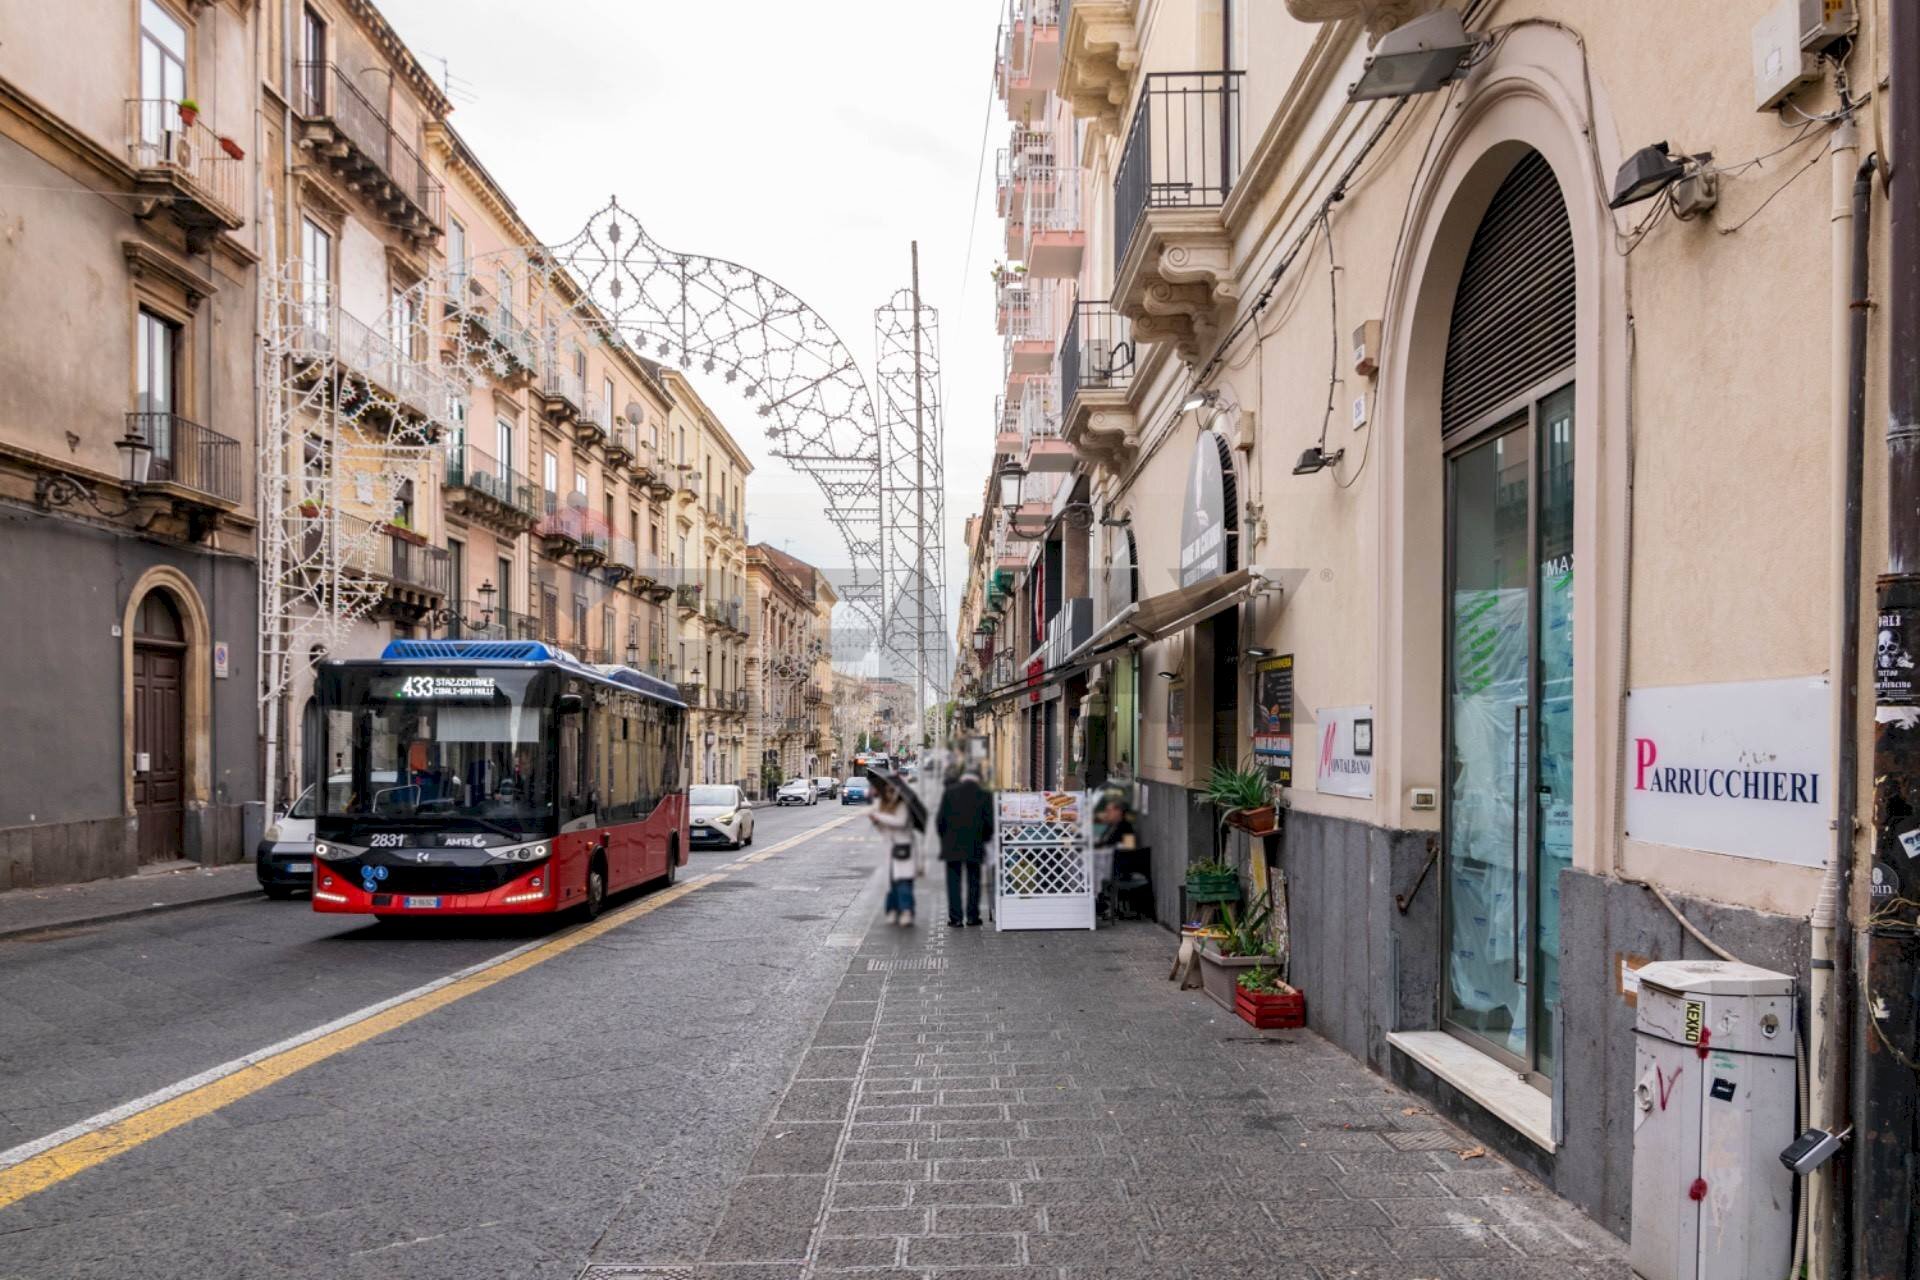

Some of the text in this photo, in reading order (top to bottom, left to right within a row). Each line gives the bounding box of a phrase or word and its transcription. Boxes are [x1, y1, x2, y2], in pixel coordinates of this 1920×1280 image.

[402, 676, 433, 697] 433
[1633, 737, 1820, 804] PARRUCCHIERI
[370, 833, 405, 847] 2831
[444, 837, 471, 846] AMTS
